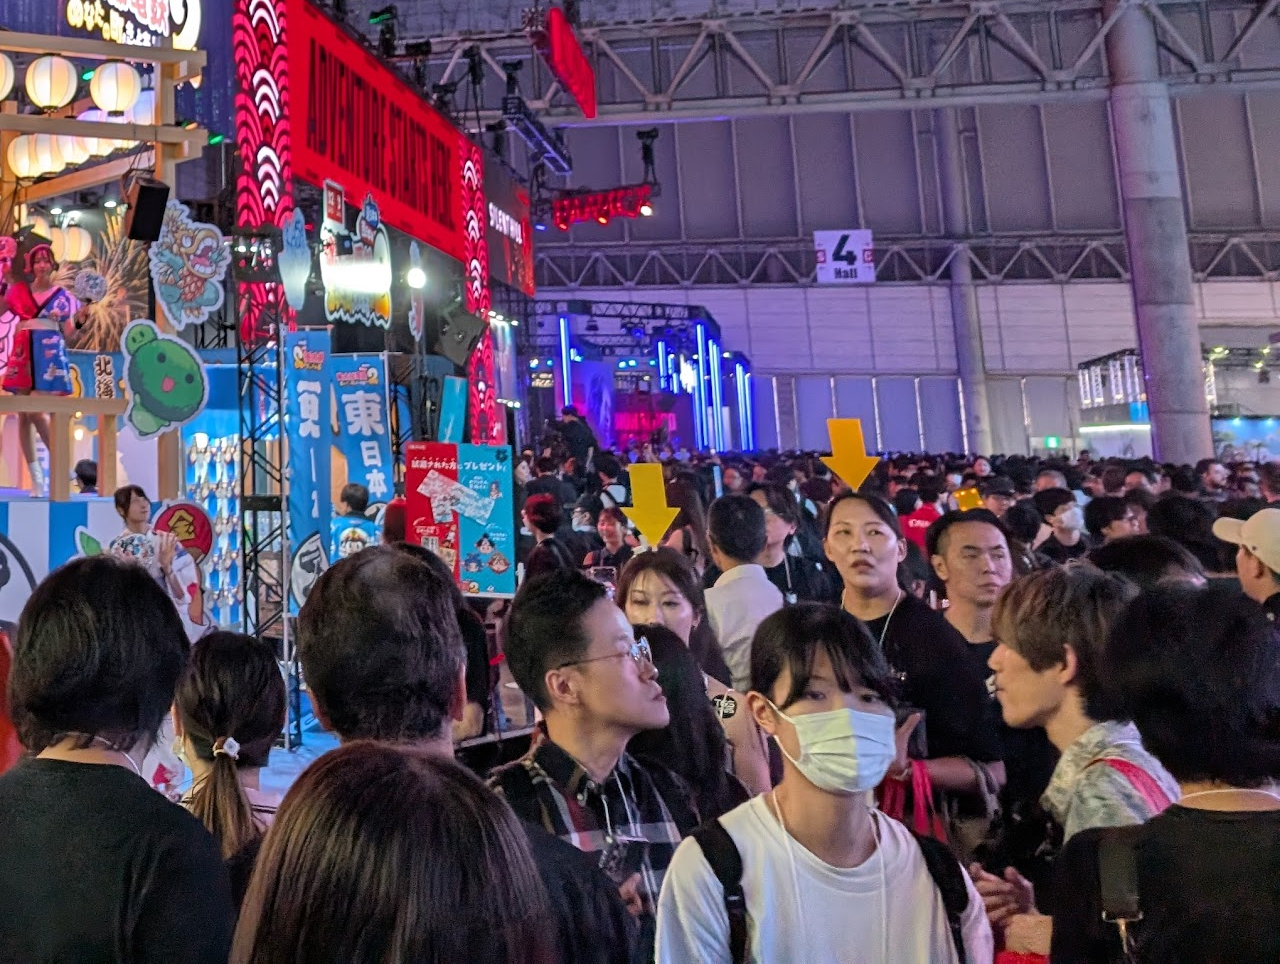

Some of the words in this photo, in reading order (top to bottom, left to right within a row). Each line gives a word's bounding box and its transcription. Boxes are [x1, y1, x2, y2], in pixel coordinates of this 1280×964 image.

[832, 234, 857, 265] 4
[834, 267, 858, 279] Hall
[340, 390, 385, 498] 東日本
